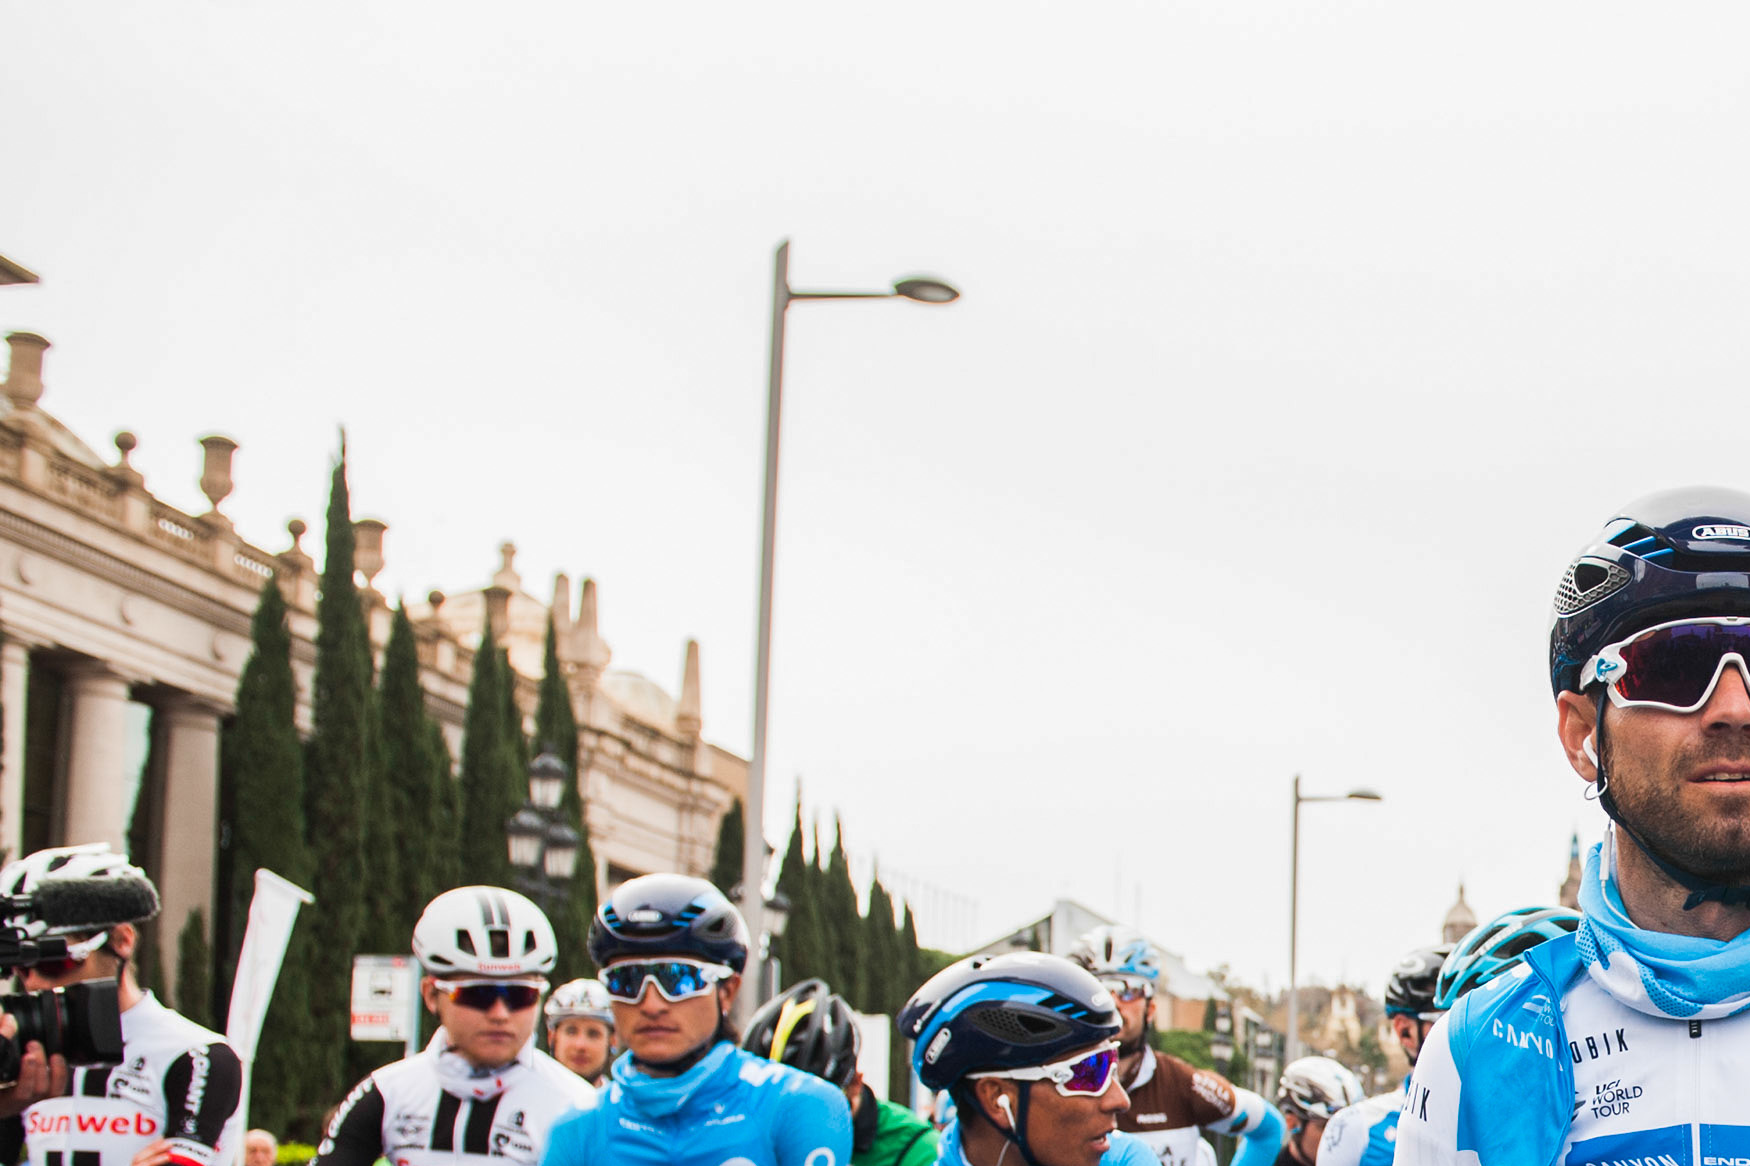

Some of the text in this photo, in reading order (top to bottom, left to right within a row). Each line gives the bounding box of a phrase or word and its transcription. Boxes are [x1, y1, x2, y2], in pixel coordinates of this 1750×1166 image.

[1700, 527, 1749, 538] ABUS
[1493, 1018, 1553, 1060] CANYO
[1570, 1029, 1629, 1064] OBIK
[1592, 1086, 1643, 1105] WORLD
[1595, 1079, 1621, 1095] UCI
[1591, 1102, 1630, 1119] TOUR
[27, 1110, 157, 1136] Sunweb
